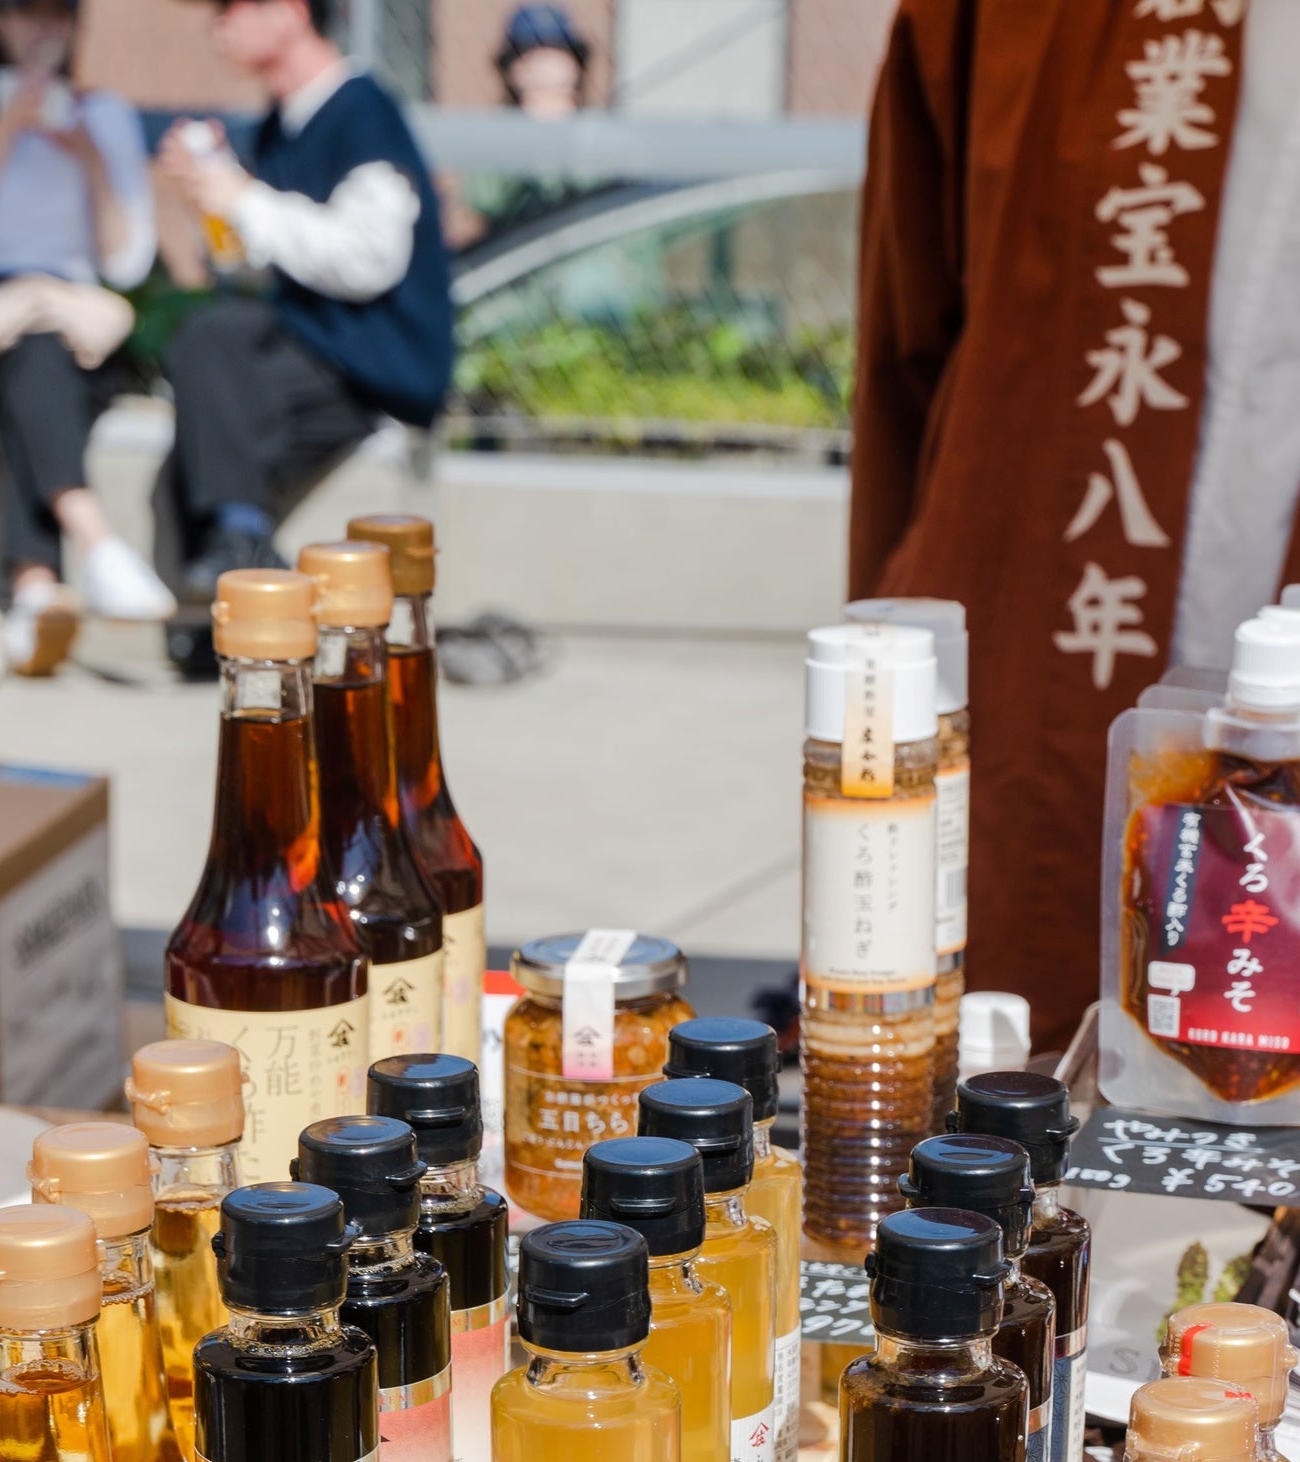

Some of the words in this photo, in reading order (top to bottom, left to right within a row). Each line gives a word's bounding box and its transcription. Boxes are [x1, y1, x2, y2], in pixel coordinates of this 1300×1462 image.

[1053, 0, 1245, 690] 業宝永八年
[1222, 831, 1279, 1013] くろ辛みそ
